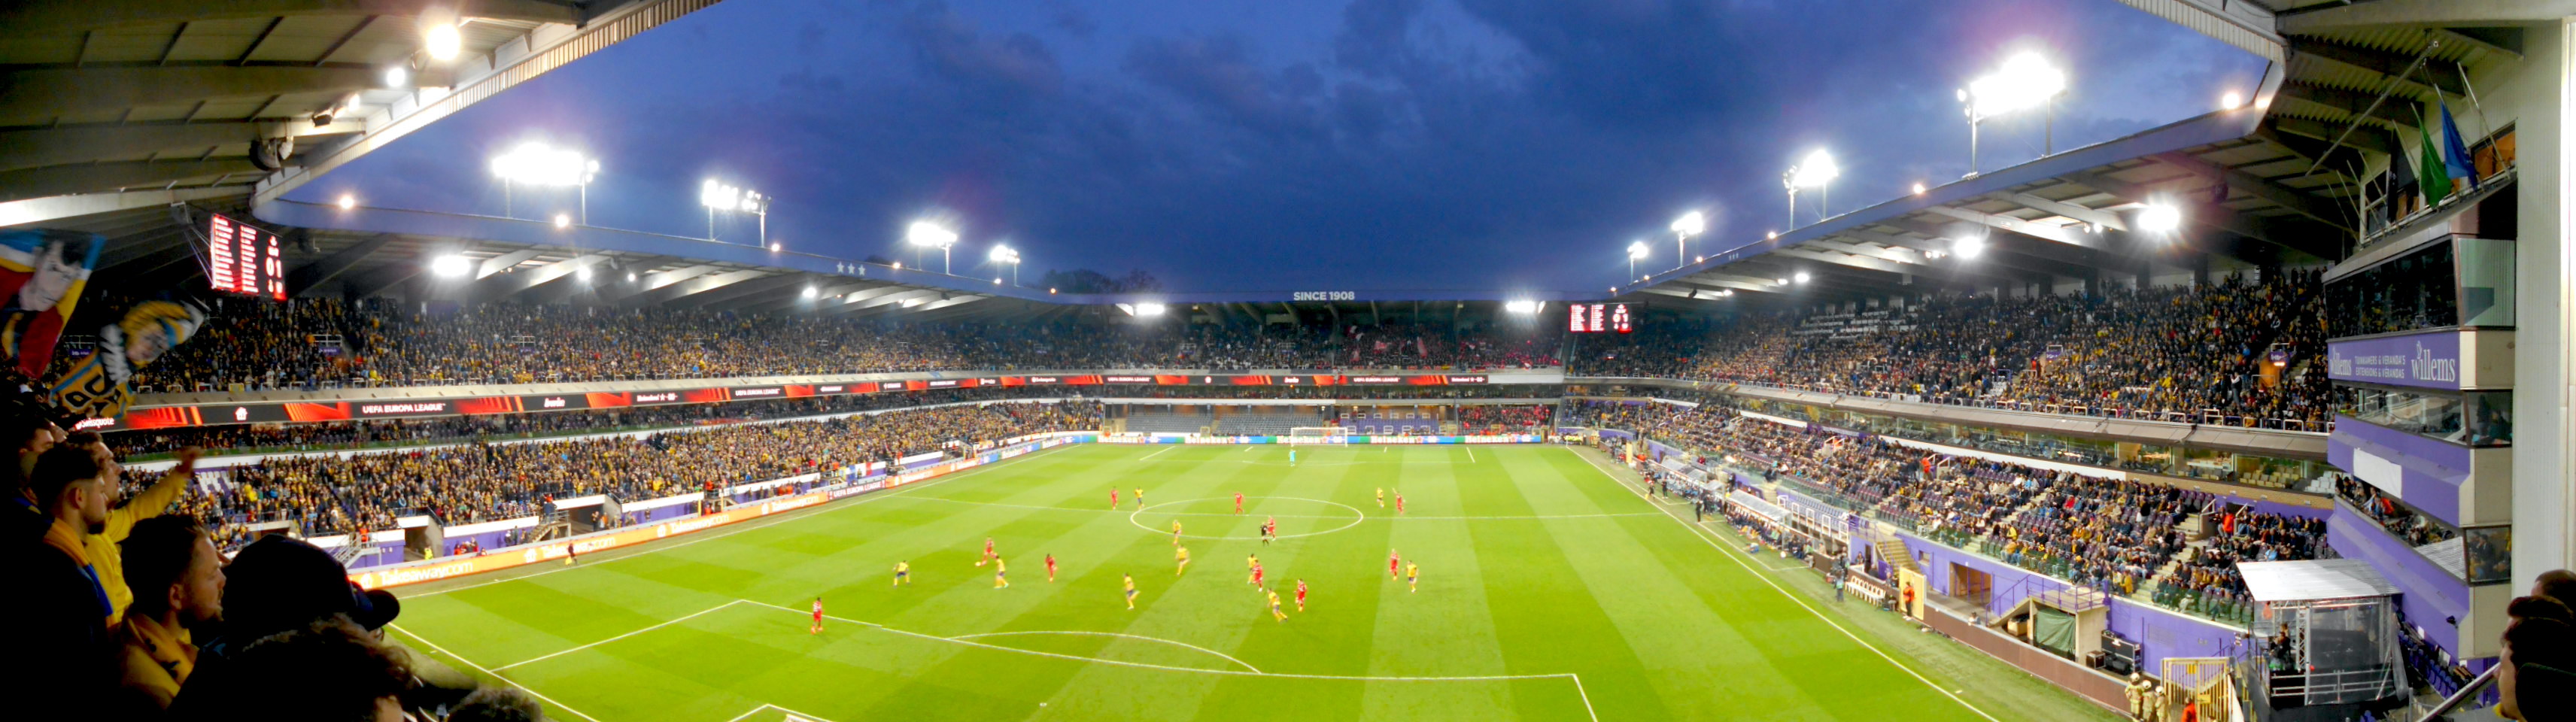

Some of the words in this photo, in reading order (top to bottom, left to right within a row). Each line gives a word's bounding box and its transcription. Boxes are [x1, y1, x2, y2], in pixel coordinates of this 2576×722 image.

[1294, 291, 1326, 301] SINCE
[1329, 291, 1356, 301] 1908
[2411, 347, 2456, 382] willems
[363, 405, 383, 414] UEFA
[384, 404, 414, 413] EUROPA
